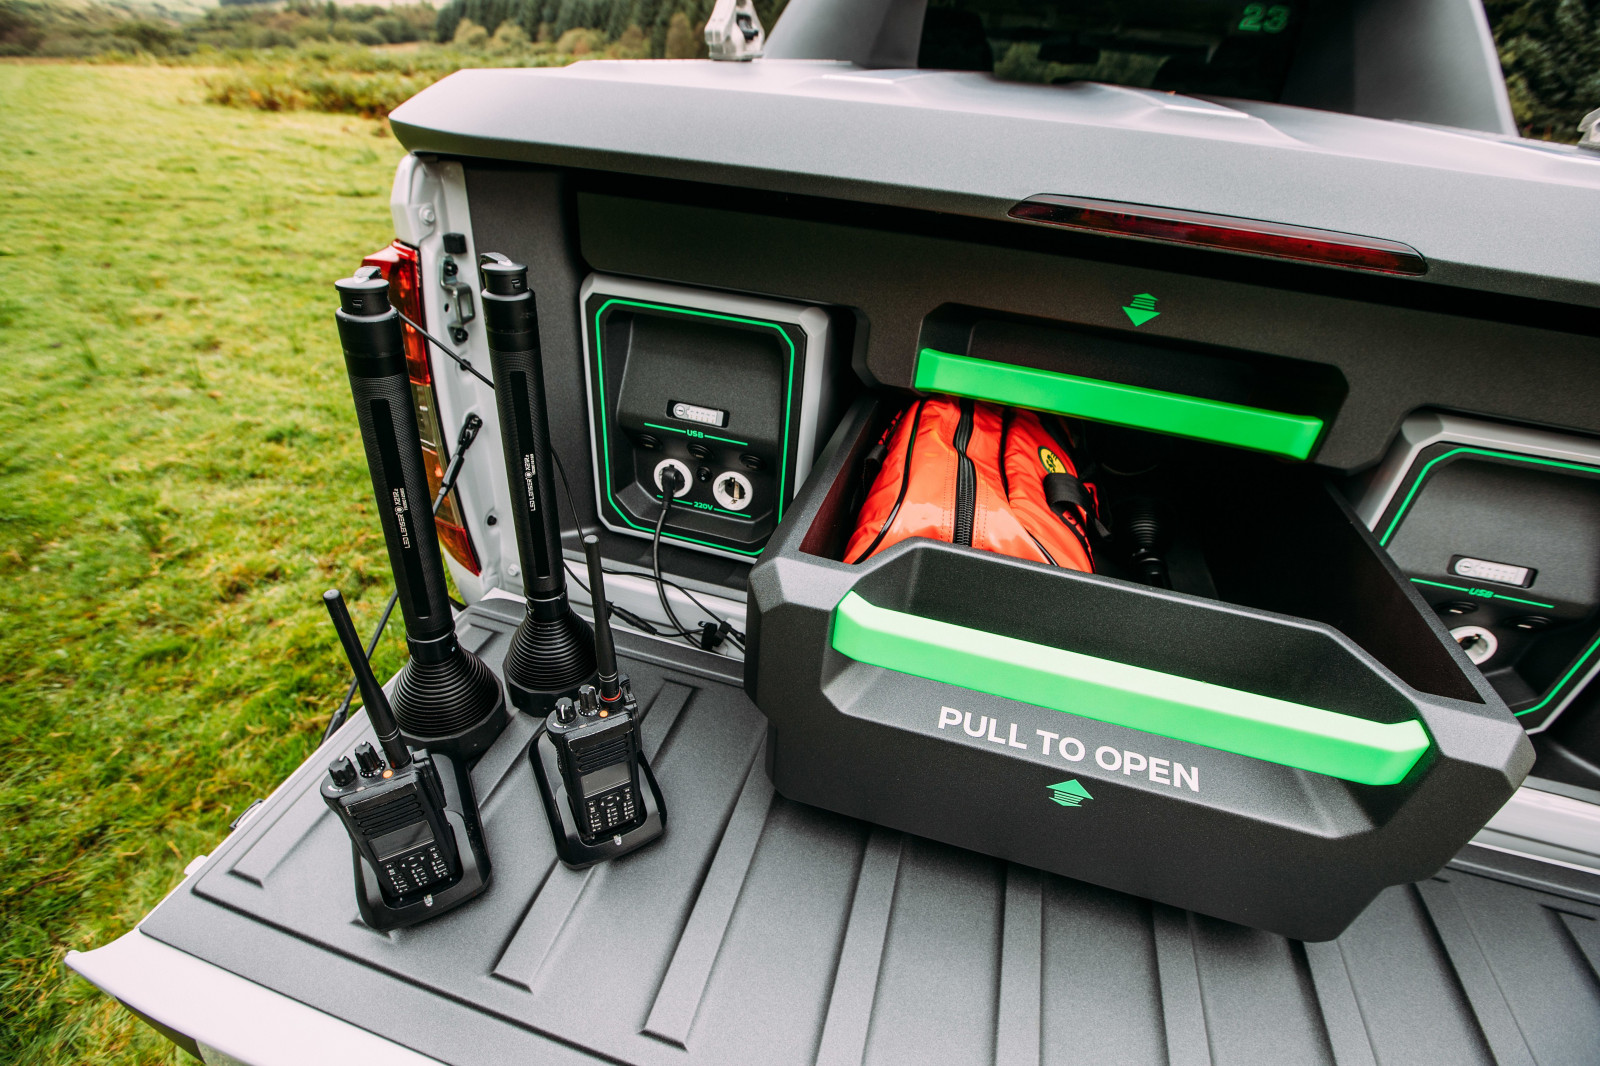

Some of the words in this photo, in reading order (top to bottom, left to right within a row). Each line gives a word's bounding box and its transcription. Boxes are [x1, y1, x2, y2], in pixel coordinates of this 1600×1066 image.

[1238, 3, 1289, 33] 23
[686, 429, 704, 439] USB
[693, 501, 714, 511] 220V
[1468, 587, 1495, 598] USB
[938, 705, 1028, 750] PULL
[1036, 729, 1086, 762] TO
[1095, 745, 1200, 793] OPEN
